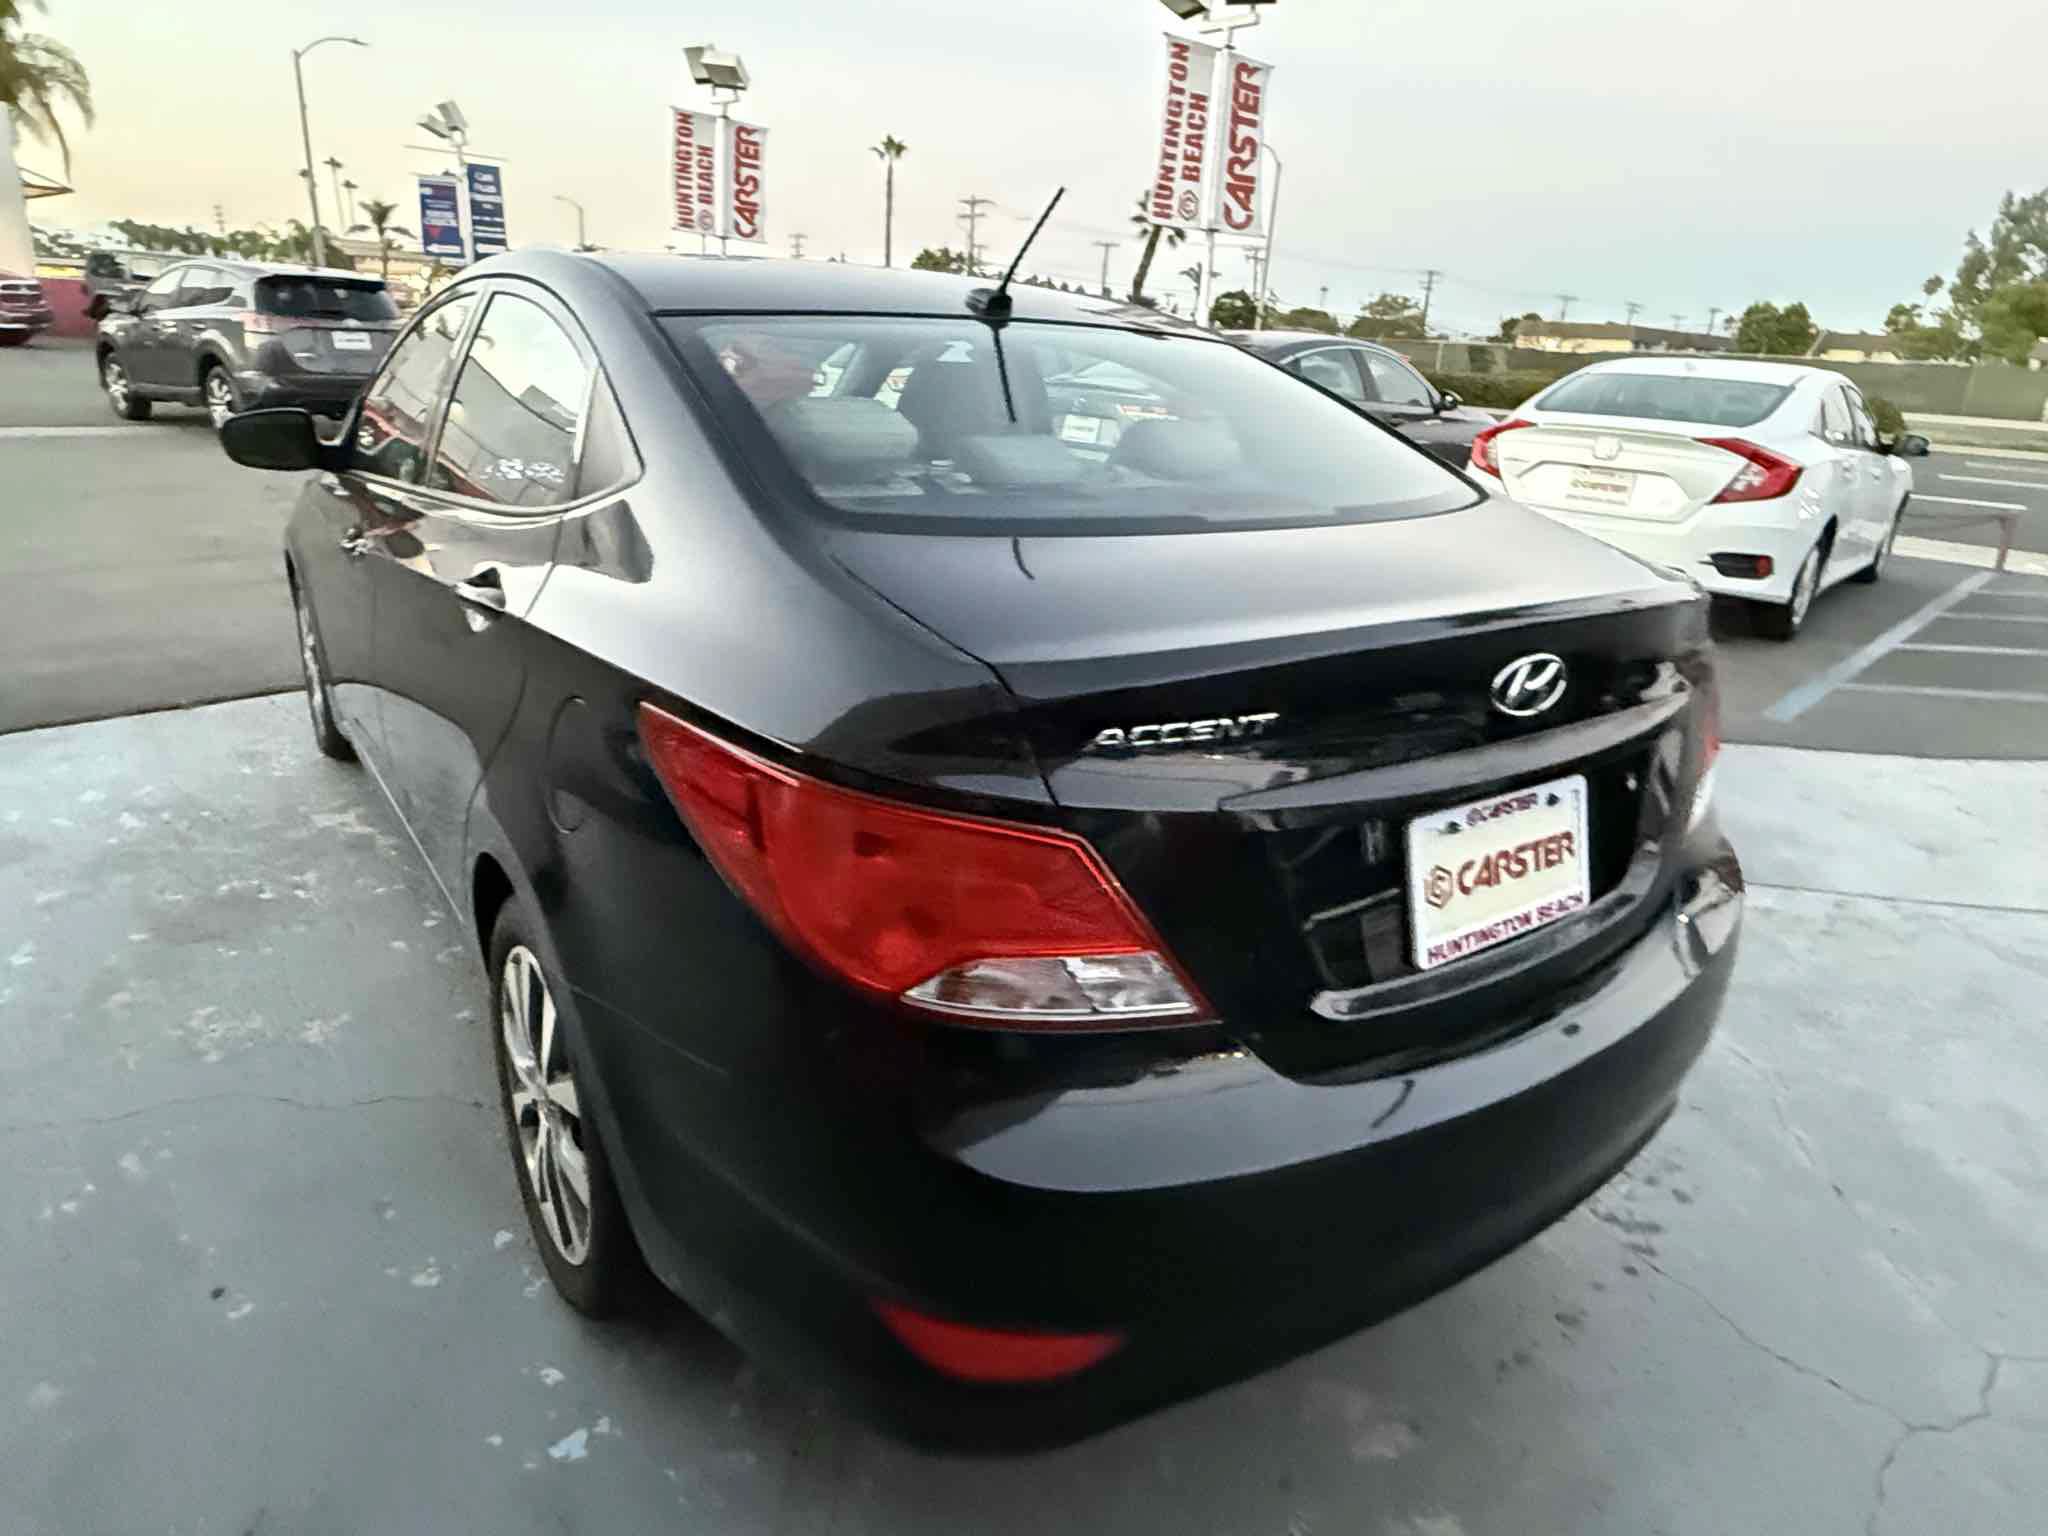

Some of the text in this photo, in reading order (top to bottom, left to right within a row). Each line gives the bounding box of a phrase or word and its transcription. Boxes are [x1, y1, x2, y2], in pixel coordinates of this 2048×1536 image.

[675, 111, 695, 229] HUNTINGTON
[696, 144, 714, 205] BEACH
[1152, 42, 1190, 220] HUNTINGTON
[1181, 91, 1209, 183] BEACH
[1223, 62, 1262, 230] CARSTER
[734, 125, 761, 238] CARSTER
[1085, 712, 1280, 749] ACCENT
[1457, 830, 1576, 897] CARSTER
[1426, 911, 1533, 964] HUNTINGTON
